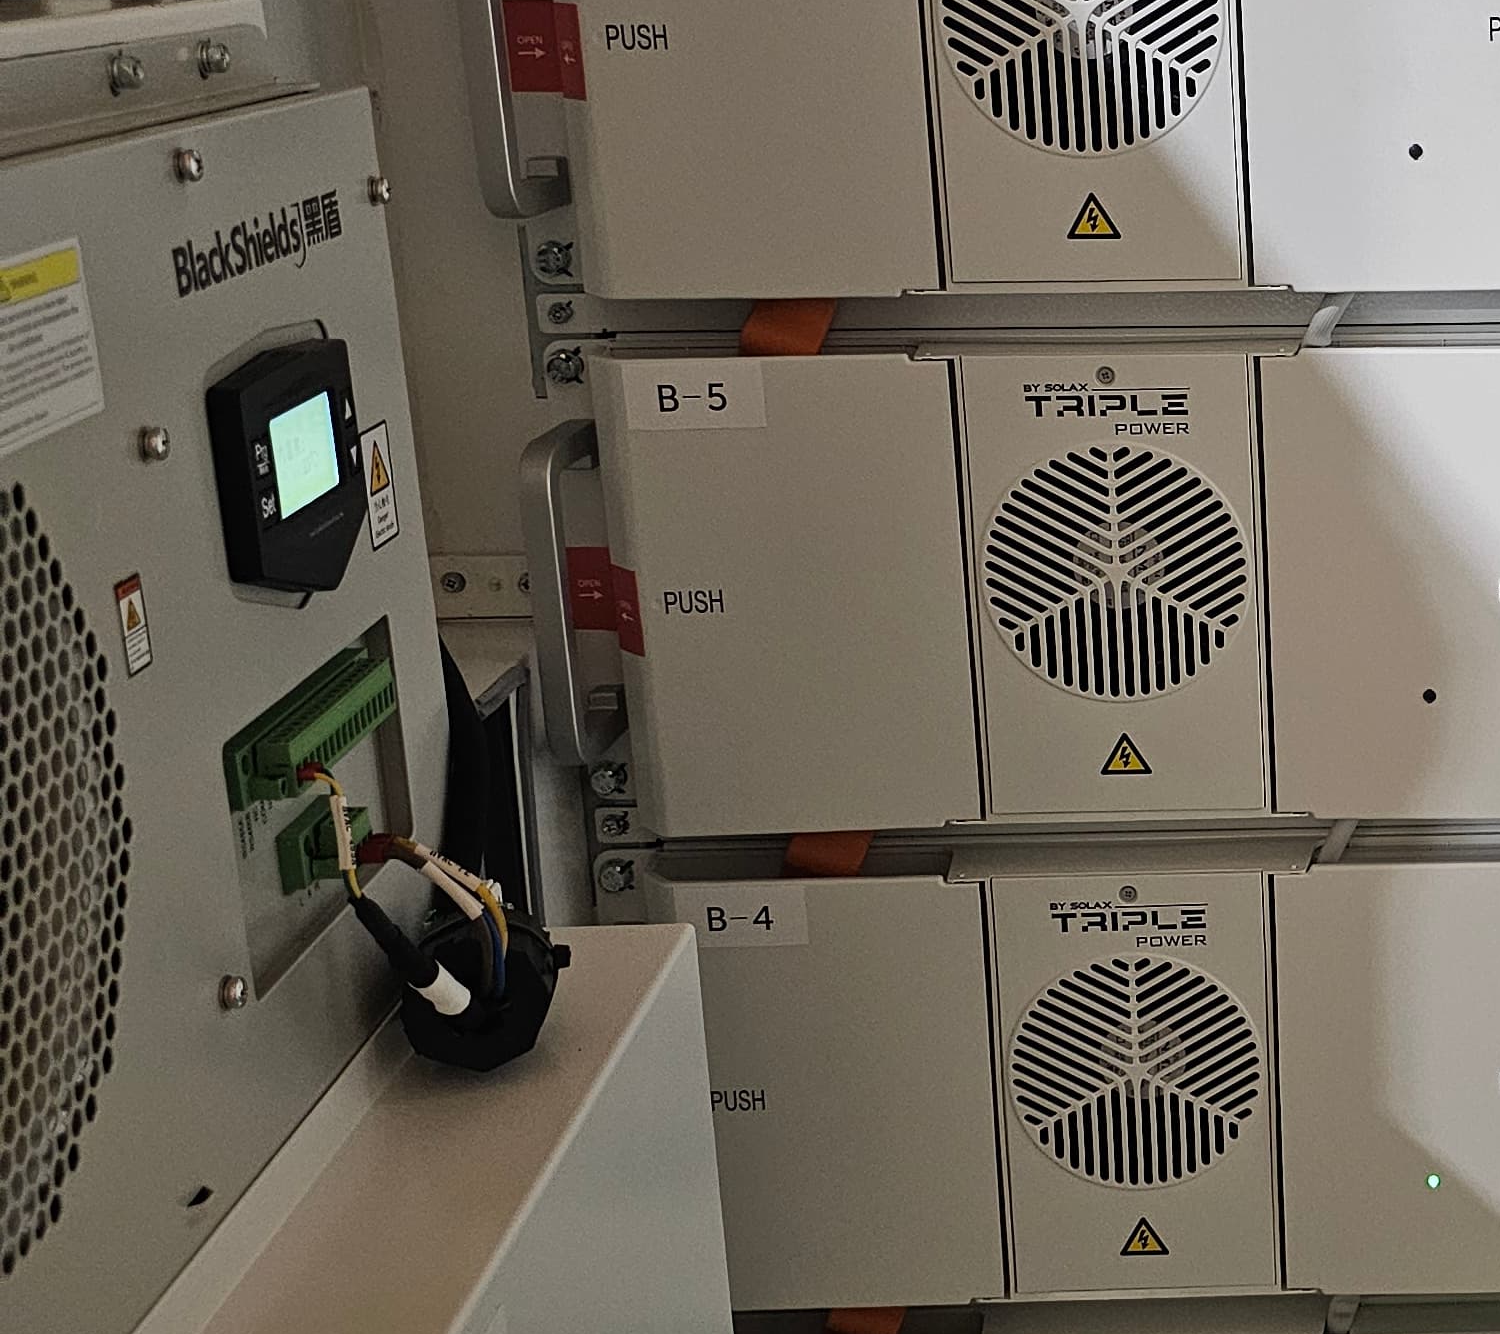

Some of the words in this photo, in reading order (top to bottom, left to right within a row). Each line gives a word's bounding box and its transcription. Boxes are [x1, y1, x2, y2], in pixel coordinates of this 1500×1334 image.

[517, 35, 543, 45] OPEN
[605, 25, 668, 51] PUSH
[302, 189, 342, 247] 黑盾
[172, 206, 301, 298] BlackShields
[656, 383, 728, 412] B-5
[1023, 384, 1041, 393] BY
[1044, 383, 1089, 392] SOLAX
[1025, 394, 1190, 418] TRIPLE
[1115, 422, 1190, 436] POWER
[663, 589, 725, 614] PUSH
[1049, 901, 1068, 911] BY
[1070, 900, 1112, 910] SOLAX
[706, 905, 774, 932] B-4
[1051, 909, 1207, 933] TRIPLE
[1136, 934, 1207, 948] POWER
[710, 1089, 766, 1111] PUSH
